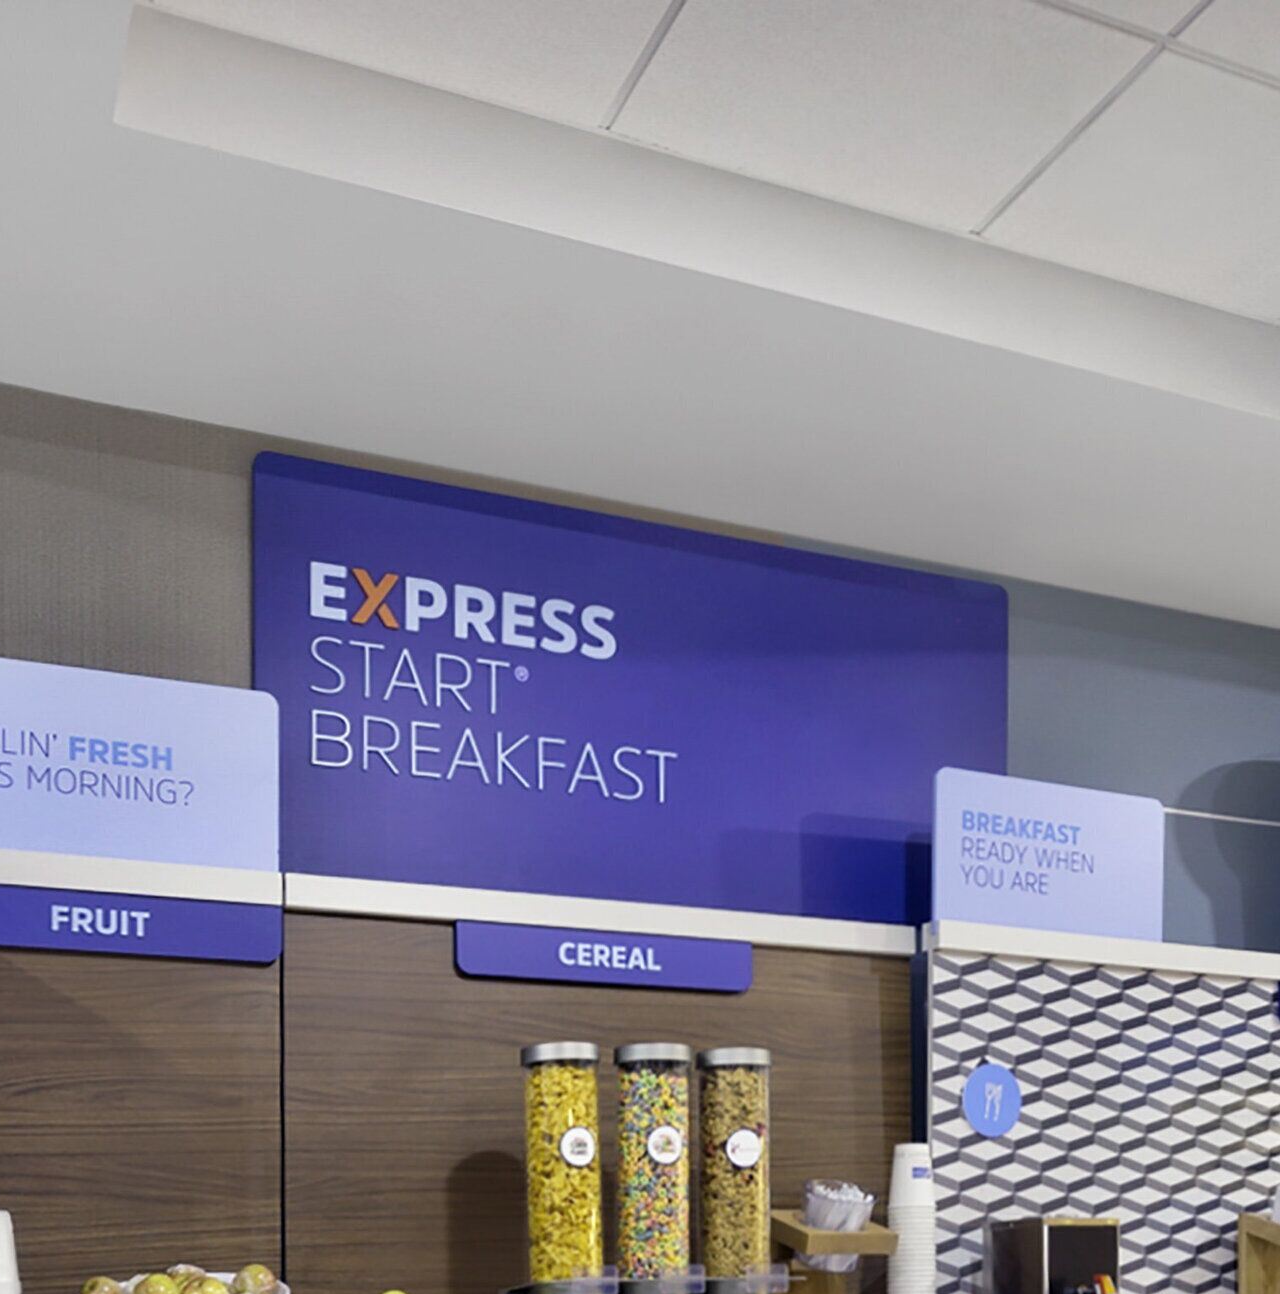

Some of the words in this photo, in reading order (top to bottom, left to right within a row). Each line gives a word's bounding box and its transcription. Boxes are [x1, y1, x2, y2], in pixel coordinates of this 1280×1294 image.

[310, 561, 617, 660] EXPRESS
[69, 736, 173, 771] FRESH
[310, 709, 678, 803] BREAKFAST
[27, 766, 195, 806] MORNING?
[962, 810, 1081, 845] BREAKFAST
[961, 836, 1028, 865] READY
[1035, 847, 1095, 874] WHEN
[961, 864, 1004, 889] YOU
[1010, 871, 1049, 895] ARE
[50, 905, 151, 938] FRUIT
[558, 941, 662, 971] CEREAL
